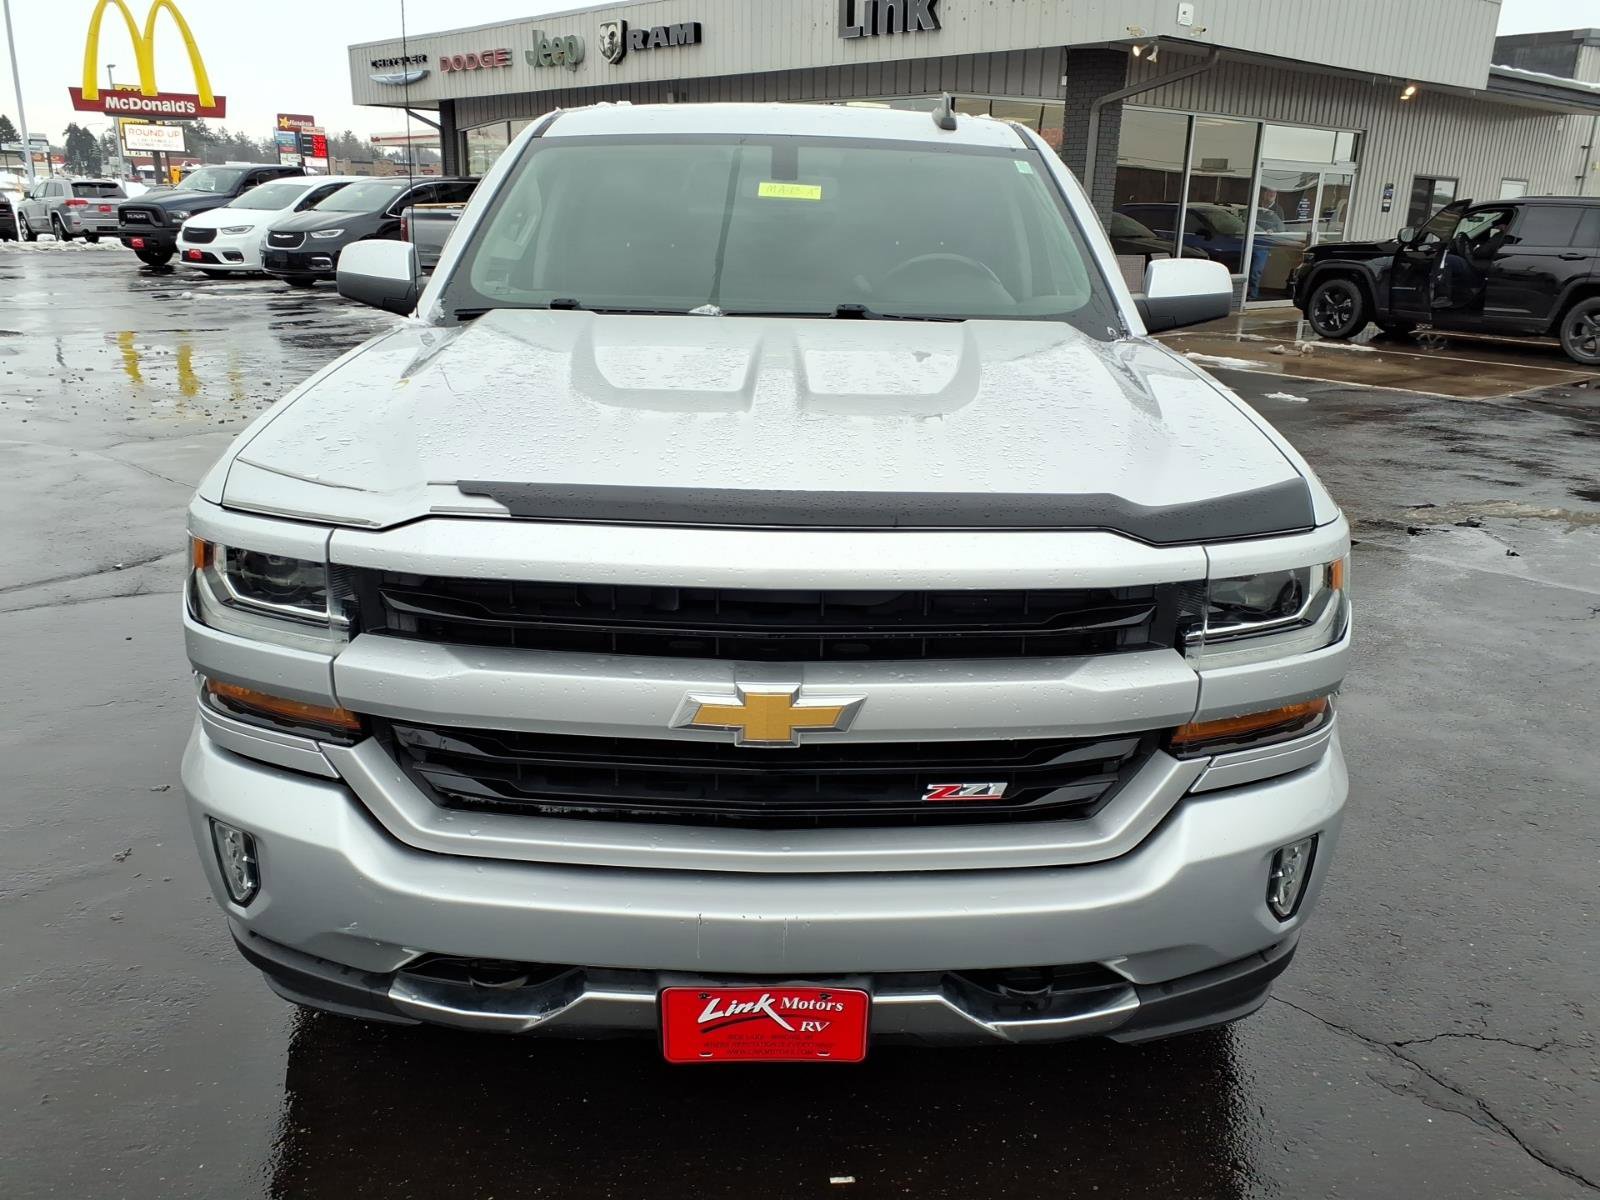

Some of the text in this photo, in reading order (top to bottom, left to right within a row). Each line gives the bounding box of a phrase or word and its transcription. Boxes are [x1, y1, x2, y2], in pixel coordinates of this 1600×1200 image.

[838, 0, 940, 38] Link
[626, 22, 701, 50] RAM
[440, 48, 512, 72] DODGE
[525, 30, 585, 70] Jeep
[105, 97, 195, 113] McDonald's
[128, 128, 164, 137] ROUND
[922, 783, 1008, 800] Z71
[697, 994, 844, 1032] Link Motors
[800, 1021, 831, 1032] RV
